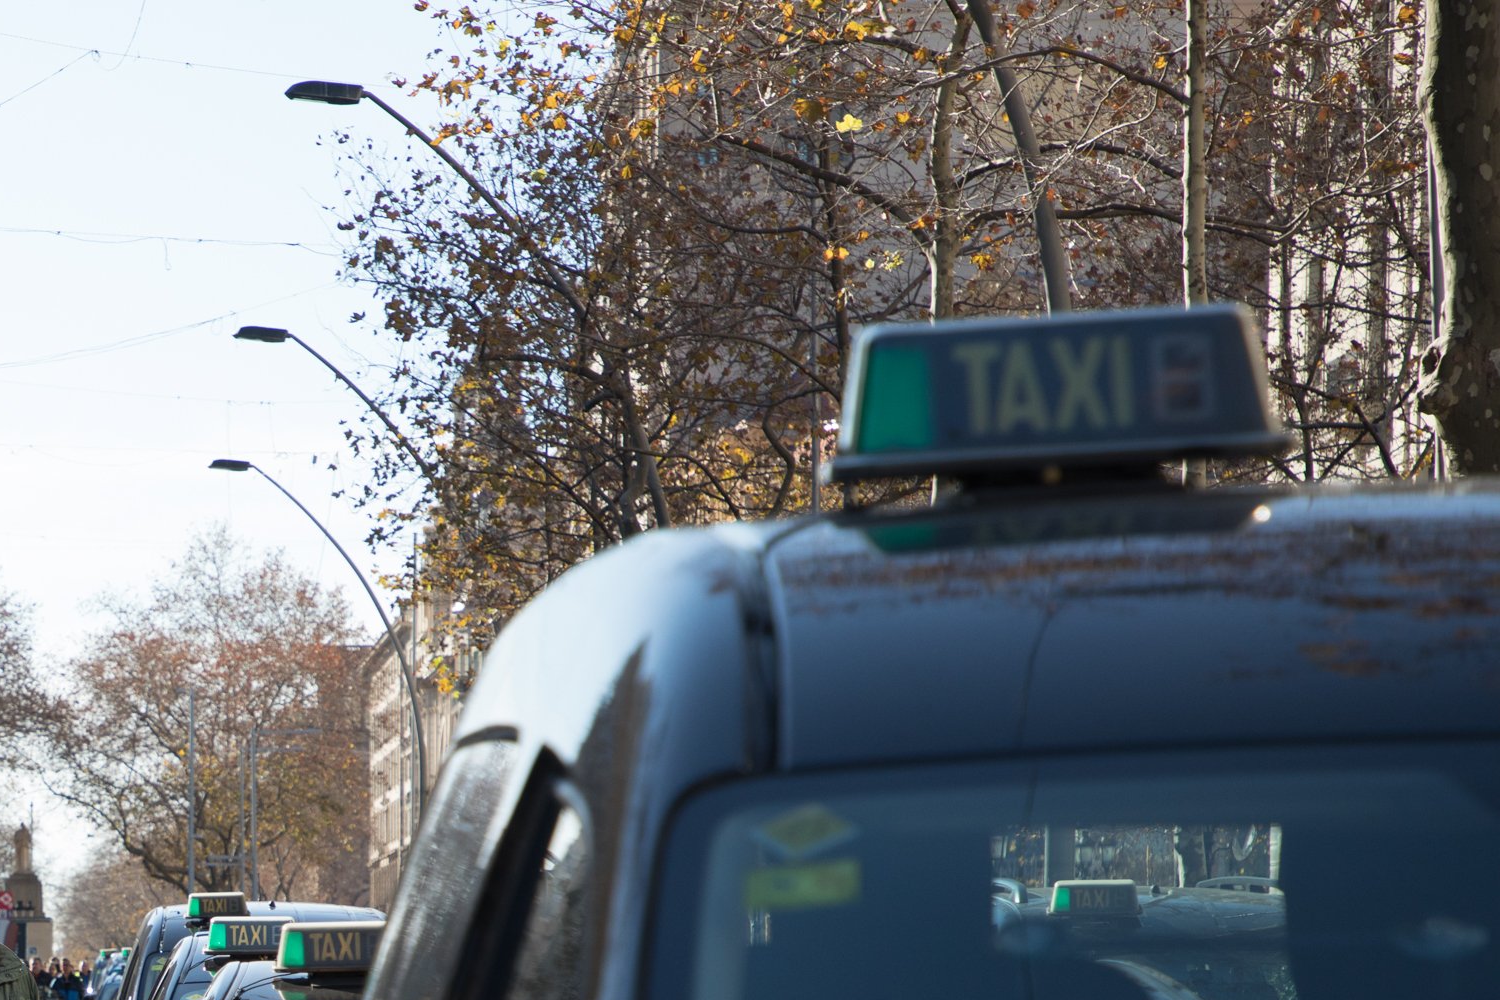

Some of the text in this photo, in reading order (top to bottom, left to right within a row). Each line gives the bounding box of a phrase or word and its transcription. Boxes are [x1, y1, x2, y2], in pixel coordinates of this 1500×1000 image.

[953, 337, 1134, 435] TAXI
[203, 899, 227, 913] TAXI
[1074, 888, 1110, 909] TAXI
[229, 924, 267, 946] TAXI
[309, 932, 361, 961] TAXI
